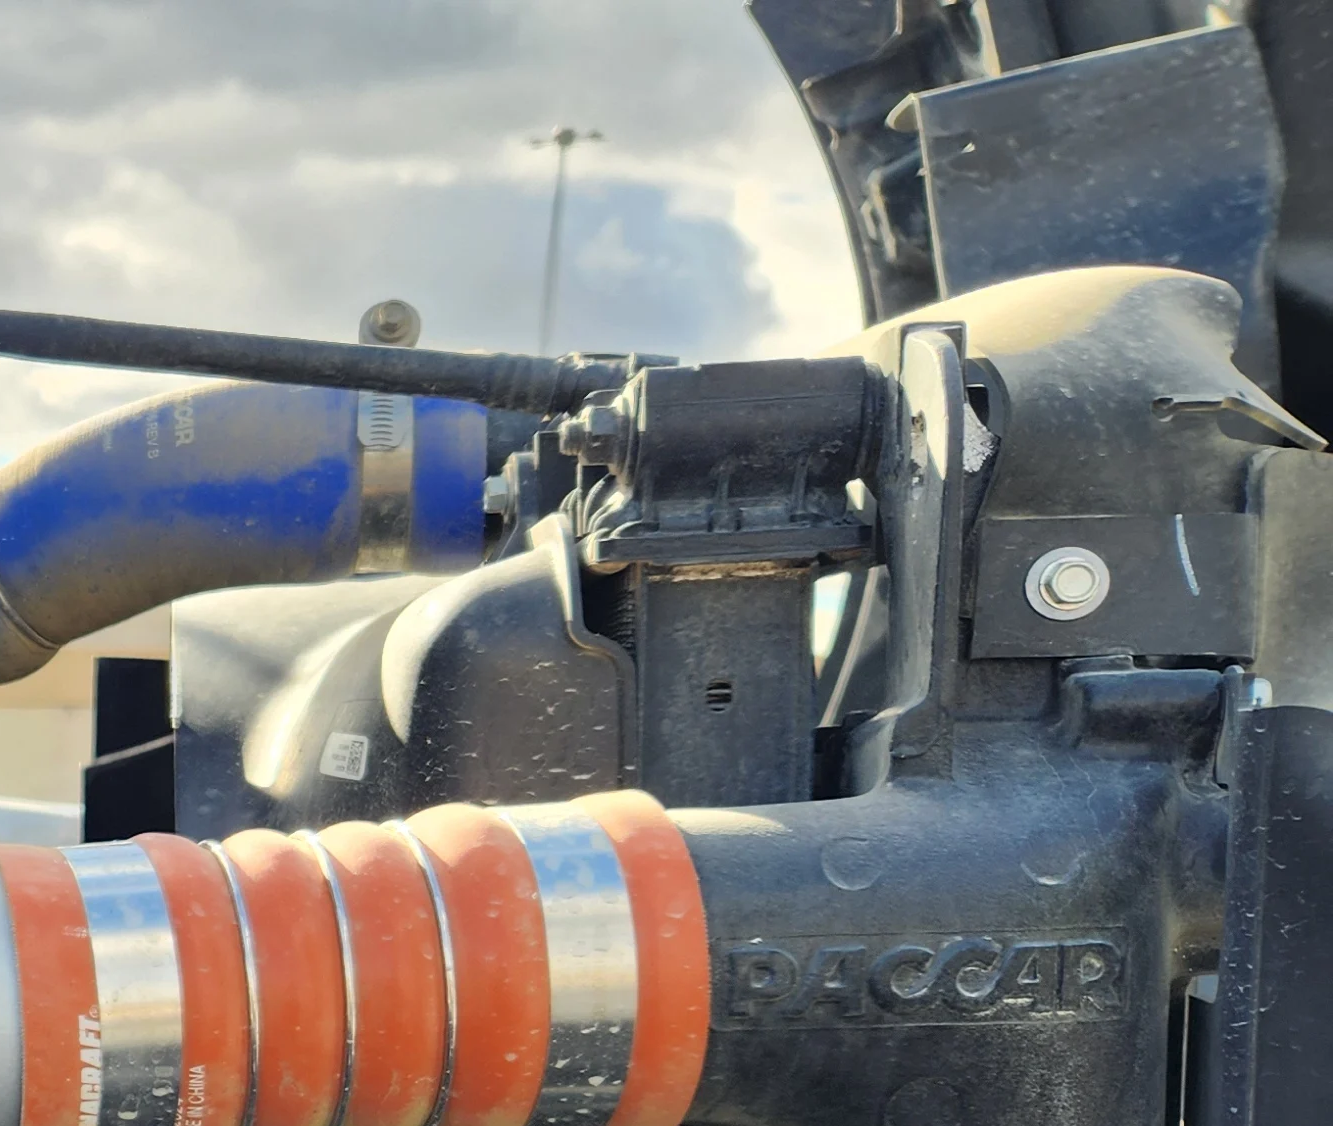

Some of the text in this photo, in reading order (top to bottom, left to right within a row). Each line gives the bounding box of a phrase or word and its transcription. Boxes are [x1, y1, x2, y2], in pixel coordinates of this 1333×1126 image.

[728, 936, 1125, 1018] PACCAR
[188, 1064, 206, 1104] CHINA
[187, 1106, 203, 1119] IN
